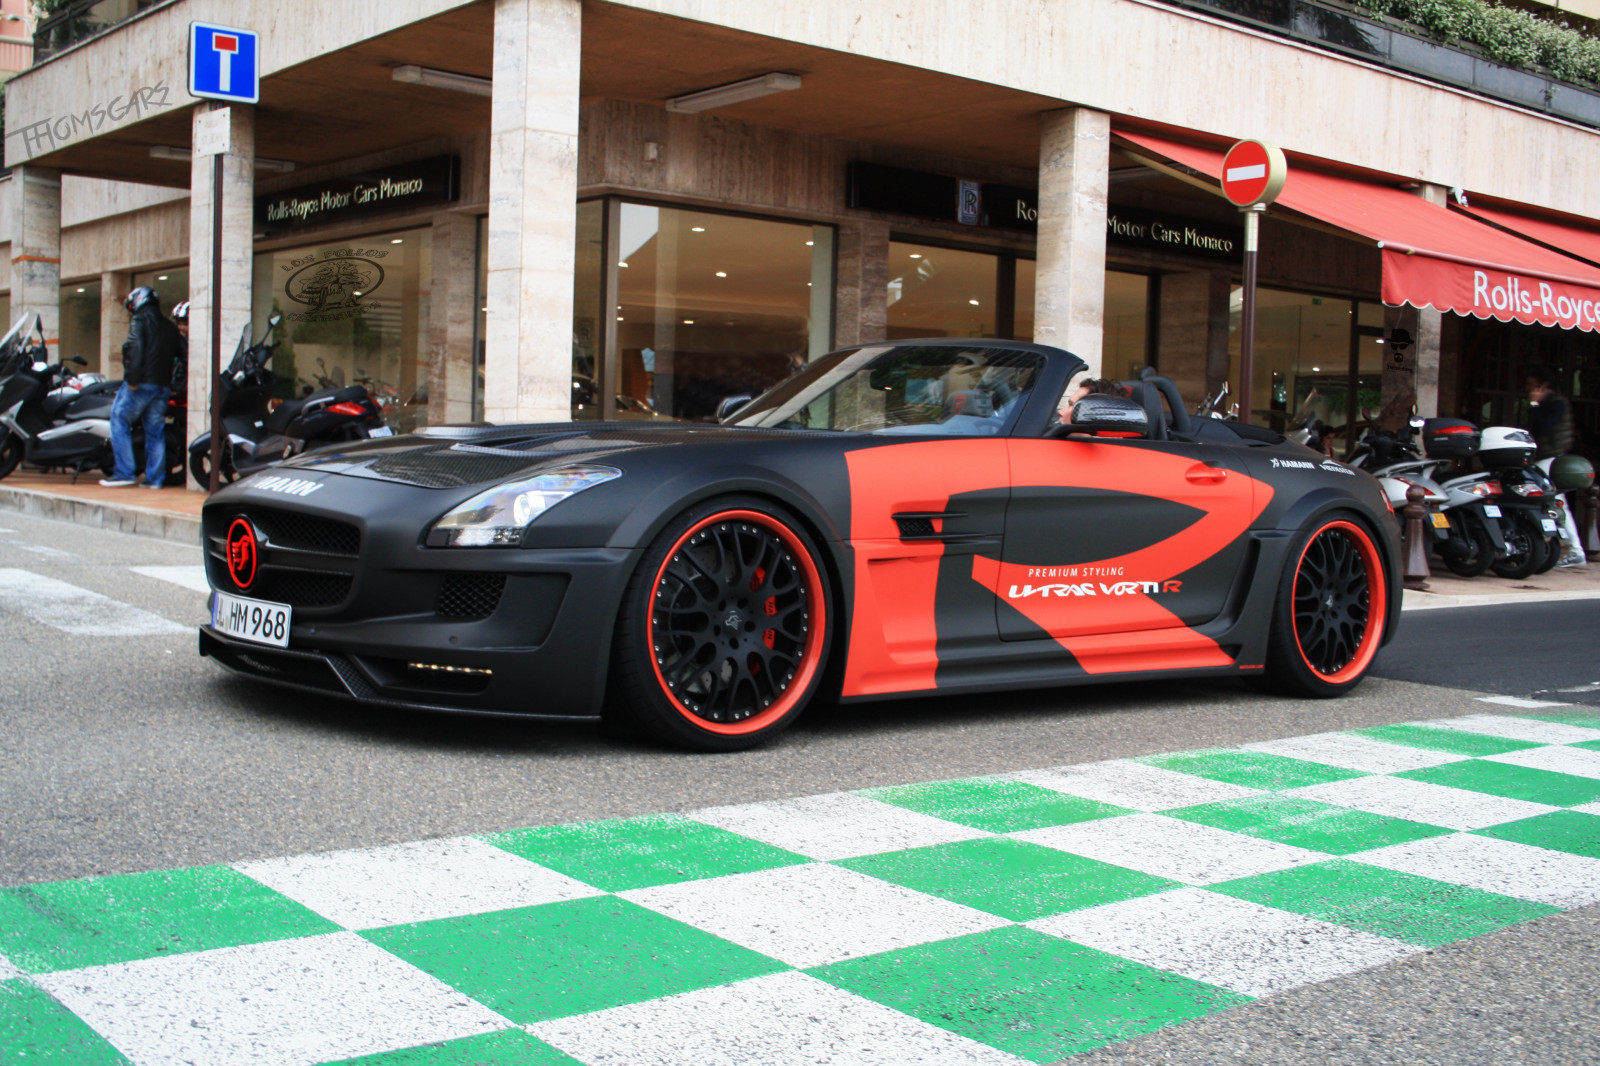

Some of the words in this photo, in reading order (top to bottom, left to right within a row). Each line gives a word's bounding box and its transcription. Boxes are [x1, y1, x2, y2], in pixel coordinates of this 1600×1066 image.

[267, 198, 318, 221] Rolls-Royce
[321, 190, 351, 211] Motor
[353, 184, 377, 204] Cars
[380, 178, 423, 200] Monaco
[1151, 222, 1181, 244] Cars
[1184, 226, 1232, 252] Monaco
[1279, 459, 1315, 469] HAMANN
[1028, 567, 1078, 578] PREMIUM
[1082, 566, 1125, 577] STYLING
[1162, 580, 1183, 593] R
[229, 601, 249, 634] HM
[252, 606, 286, 640] 968
